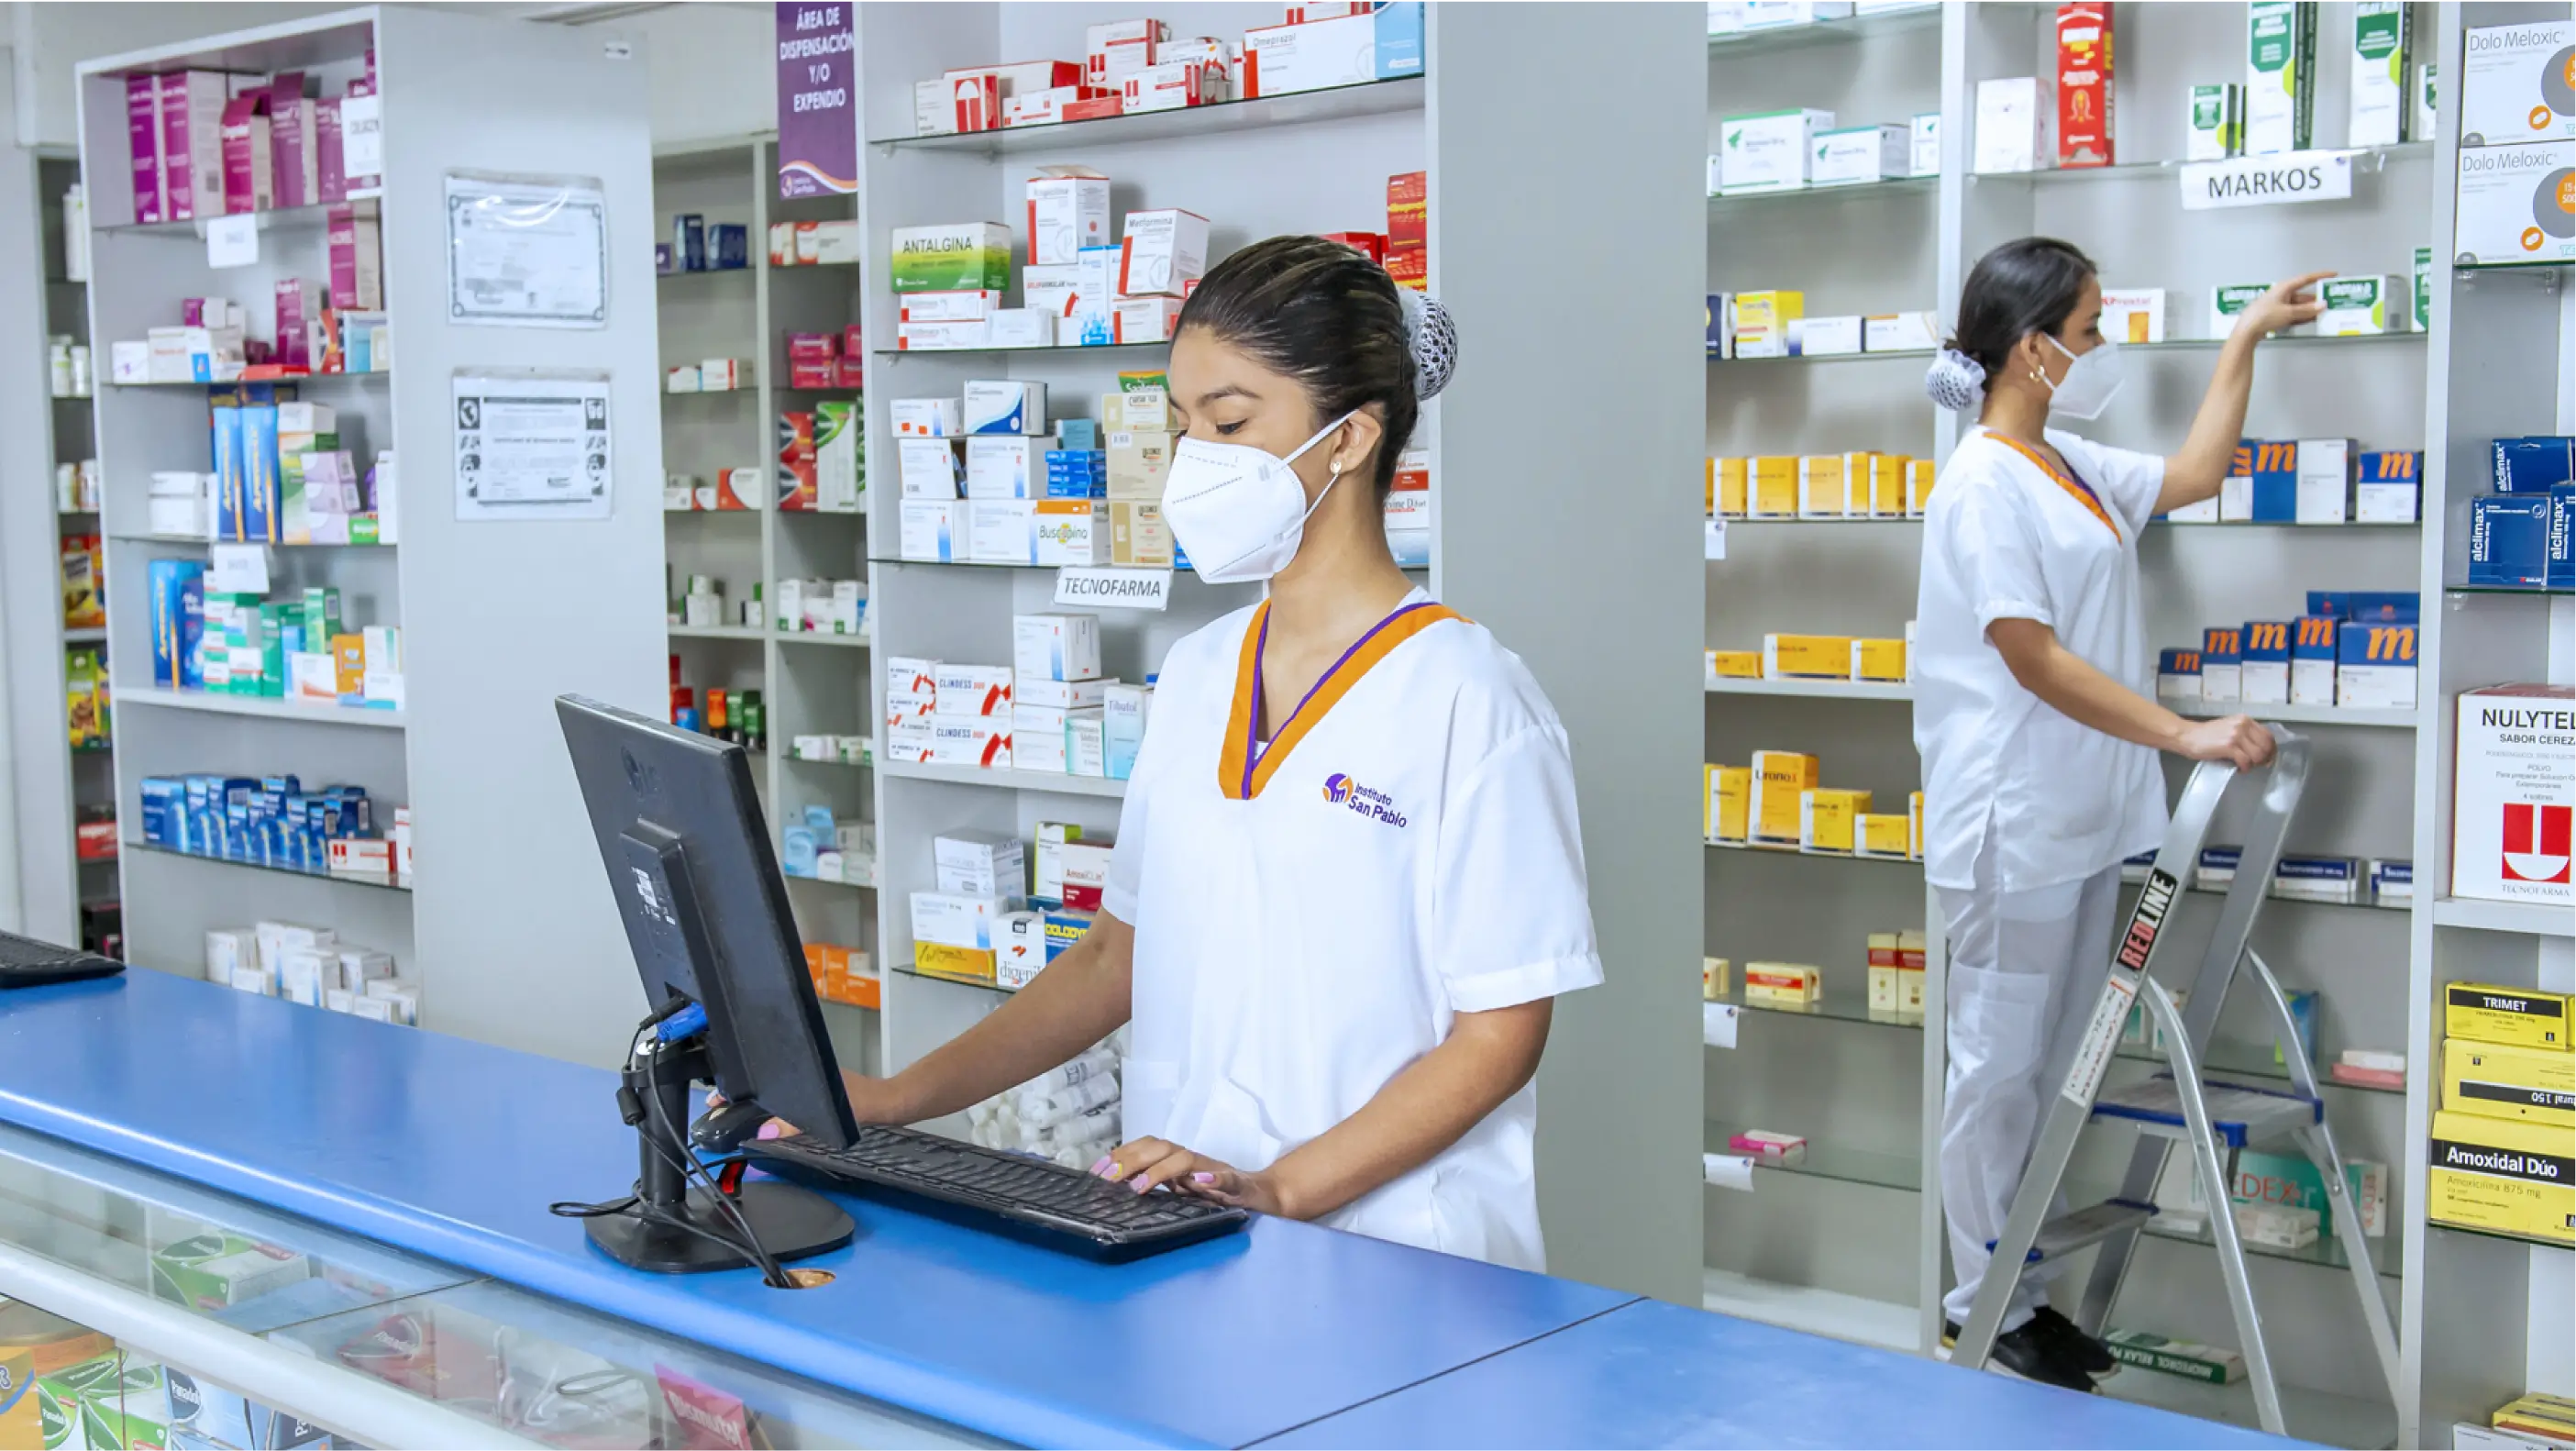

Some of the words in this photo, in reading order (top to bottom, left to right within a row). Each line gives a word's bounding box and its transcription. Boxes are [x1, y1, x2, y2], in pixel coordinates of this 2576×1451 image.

[796, 7, 824, 31] ÁREA
[826, 6, 840, 27] DE
[780, 28, 854, 61] DISPENSACIÓN
[2470, 33, 2503, 52] Dolo
[2504, 28, 2560, 49] Meloxic
[809, 63, 831, 85] Y/O
[793, 88, 846, 113] EXPENDIO
[2462, 154, 2495, 172] Dolo
[2497, 150, 2553, 170] Meloxic
[2207, 166, 2322, 199] MARKOS
[902, 237, 973, 254] ANTALGINA
[2256, 443, 2296, 472] m
[2378, 452, 2414, 479] m
[2495, 446, 2507, 492] alclimax
[2471, 507, 2484, 562] alclimax
[2551, 502, 2564, 560] alclimax
[1064, 577, 1162, 598] TECNOFARMA
[2207, 630, 2239, 655] m
[2250, 624, 2286, 650] m
[2297, 618, 2334, 647] m
[2366, 627, 2416, 660] m
[939, 678, 972, 690] CLINDESS
[2482, 709, 2576, 730] NULYTEL
[936, 728, 971, 739] CLINDESS
[2499, 734, 2537, 744] SABOR
[2538, 735, 2576, 746] CEREZ
[1354, 782, 1392, 807] Instituto
[1348, 795, 1371, 817] San
[1371, 804, 1408, 828] Pablo
[2501, 884, 2570, 898] TECNOFARMA
[2118, 873, 2176, 969] REDLINE
[2483, 996, 2528, 1013] TRIMET
[2531, 1092, 2552, 1105] 150
[2447, 1146, 2524, 1173] Amoxidal
[2527, 1157, 2559, 1178] Dúo
[2447, 1176, 2501, 1192] Amoxicilina
[2504, 1183, 2524, 1195] 875
[2526, 1189, 2541, 1200] mg
